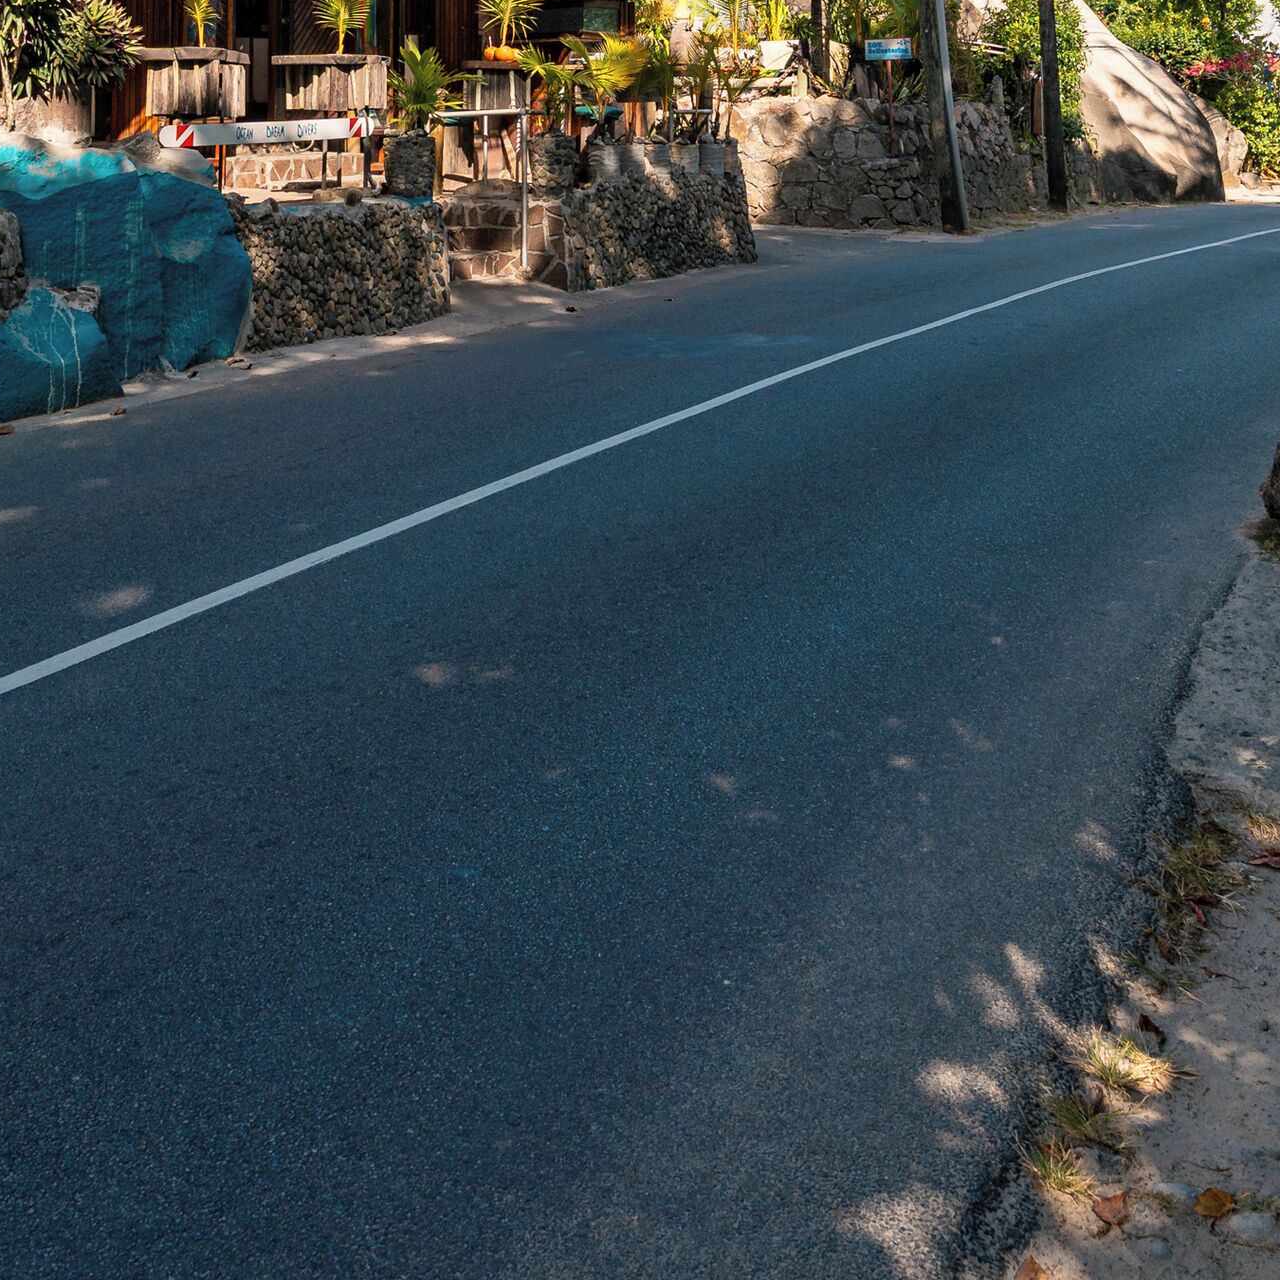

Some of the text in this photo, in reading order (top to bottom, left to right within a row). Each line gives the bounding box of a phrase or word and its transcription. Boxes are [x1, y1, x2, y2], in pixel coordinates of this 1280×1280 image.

[236, 123, 317, 140] OCEAN DREAM DIVERS
